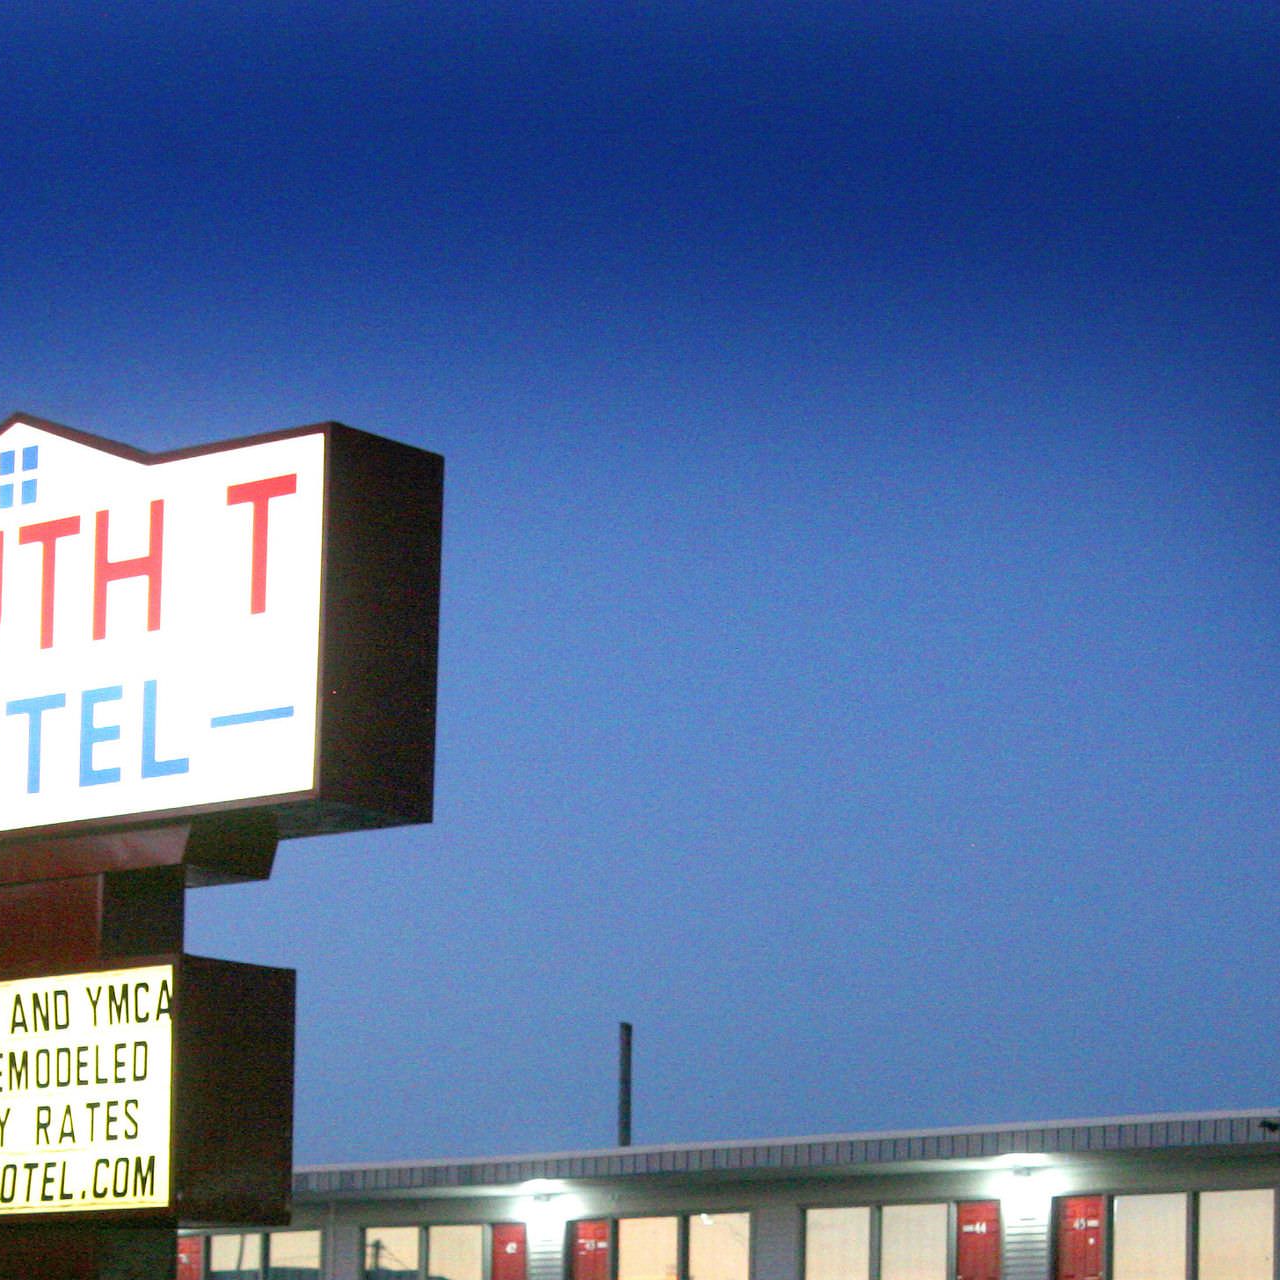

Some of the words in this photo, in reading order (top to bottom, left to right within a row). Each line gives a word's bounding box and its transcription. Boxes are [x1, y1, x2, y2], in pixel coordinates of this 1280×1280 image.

[226, 473, 298, 614] T
[10, 989, 71, 1034] AND
[86, 979, 173, 1027] YMCA
[36, 1099, 139, 1145] RATES
